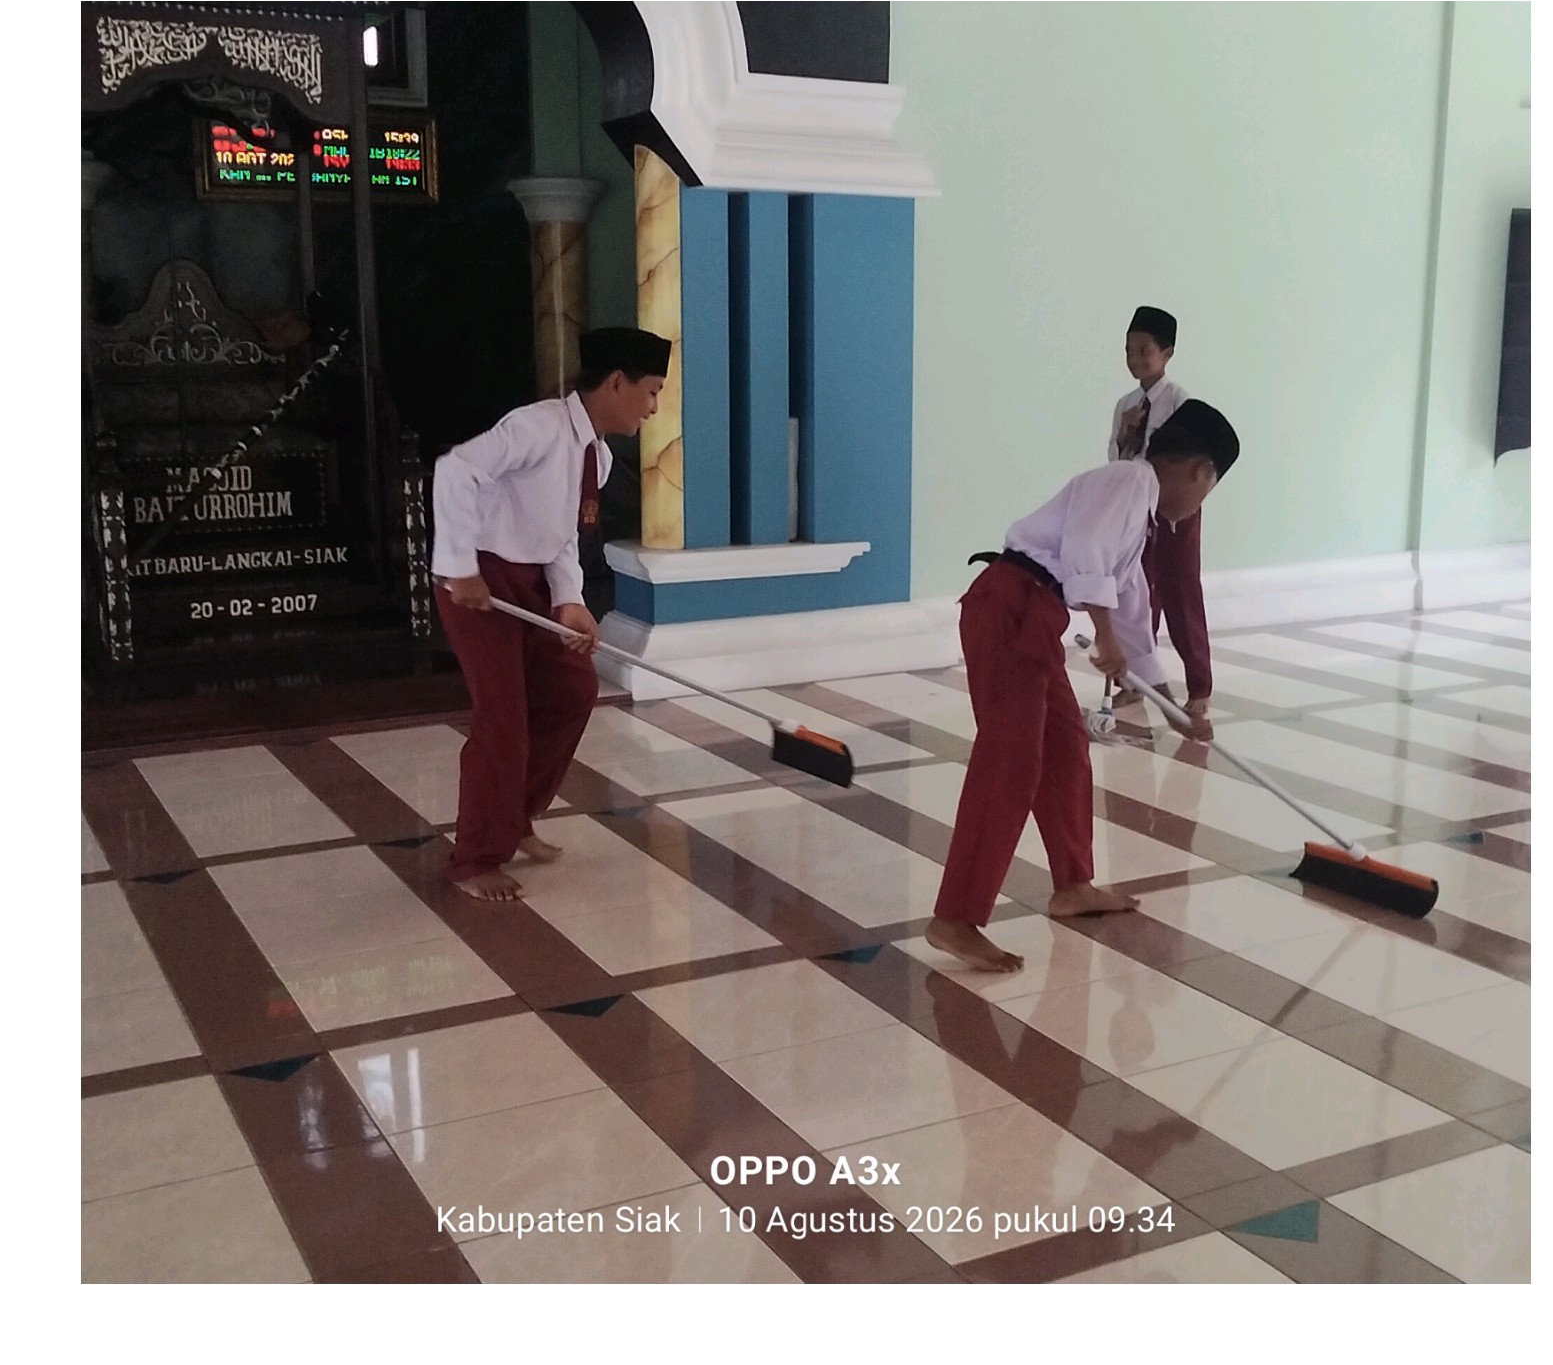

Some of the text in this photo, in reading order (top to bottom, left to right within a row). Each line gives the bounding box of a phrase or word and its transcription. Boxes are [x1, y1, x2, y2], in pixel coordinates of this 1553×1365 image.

[190, 601, 214, 620] 20
[229, 598, 253, 617] 02
[270, 593, 318, 614] 2007
